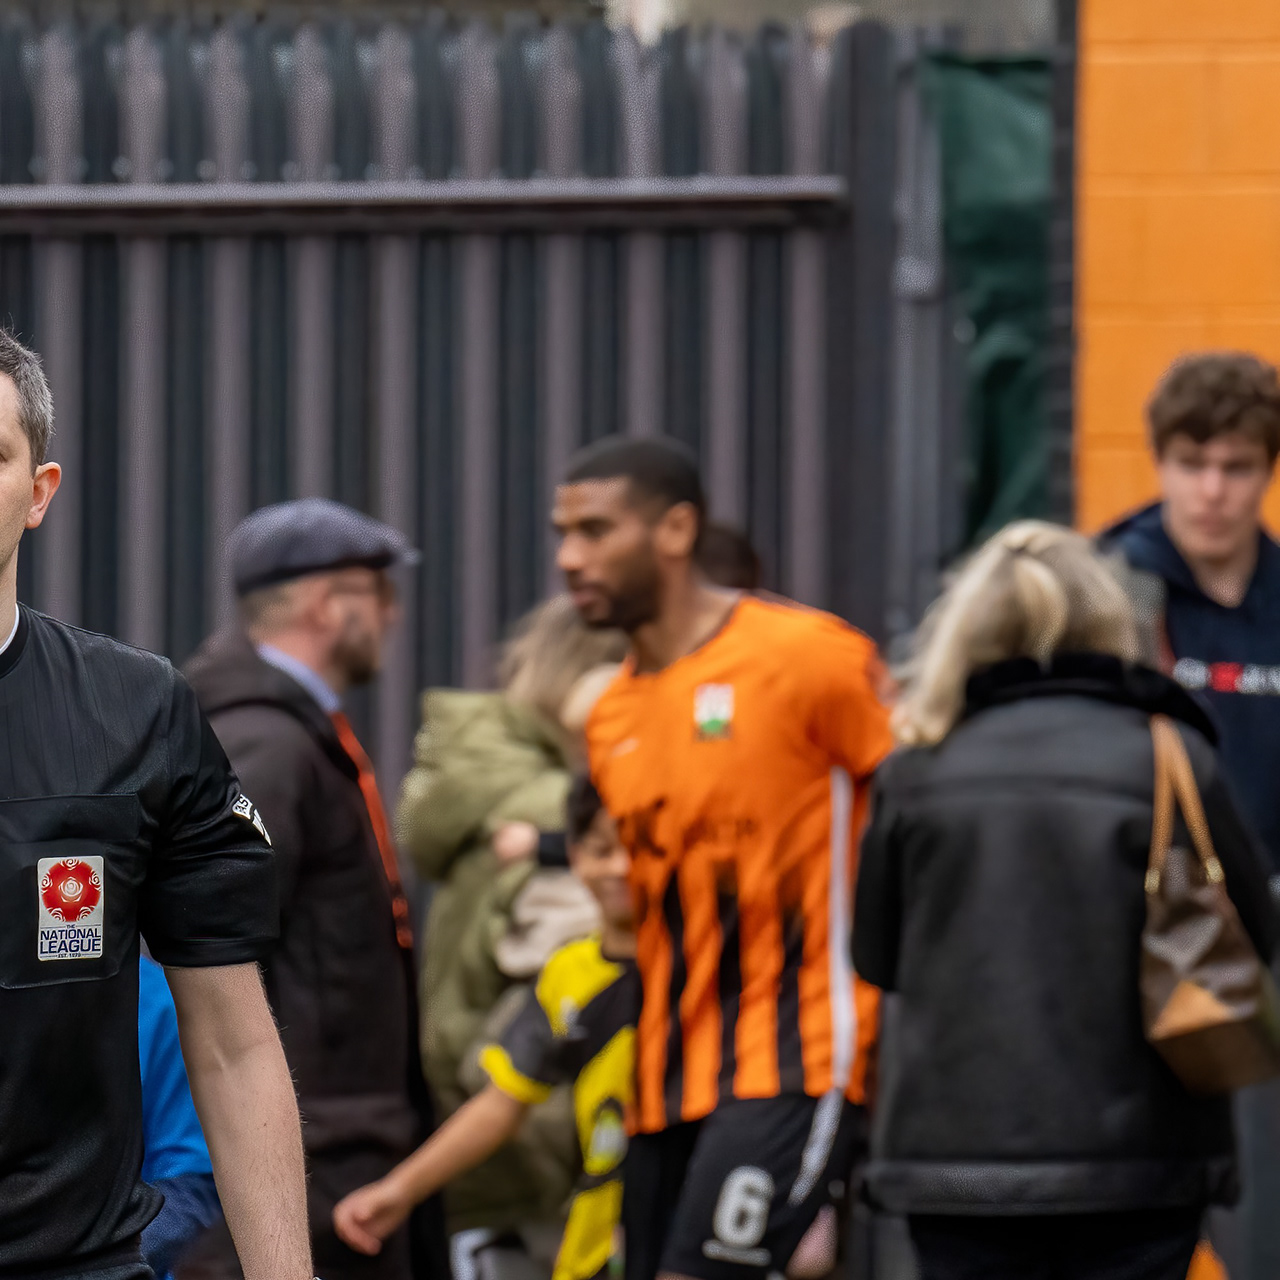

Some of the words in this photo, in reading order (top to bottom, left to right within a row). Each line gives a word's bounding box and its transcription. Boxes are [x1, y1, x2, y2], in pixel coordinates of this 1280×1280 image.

[40, 928, 101, 940] NATIONAL
[39, 939, 101, 955] LEAGUE
[713, 1165, 775, 1250] 6
